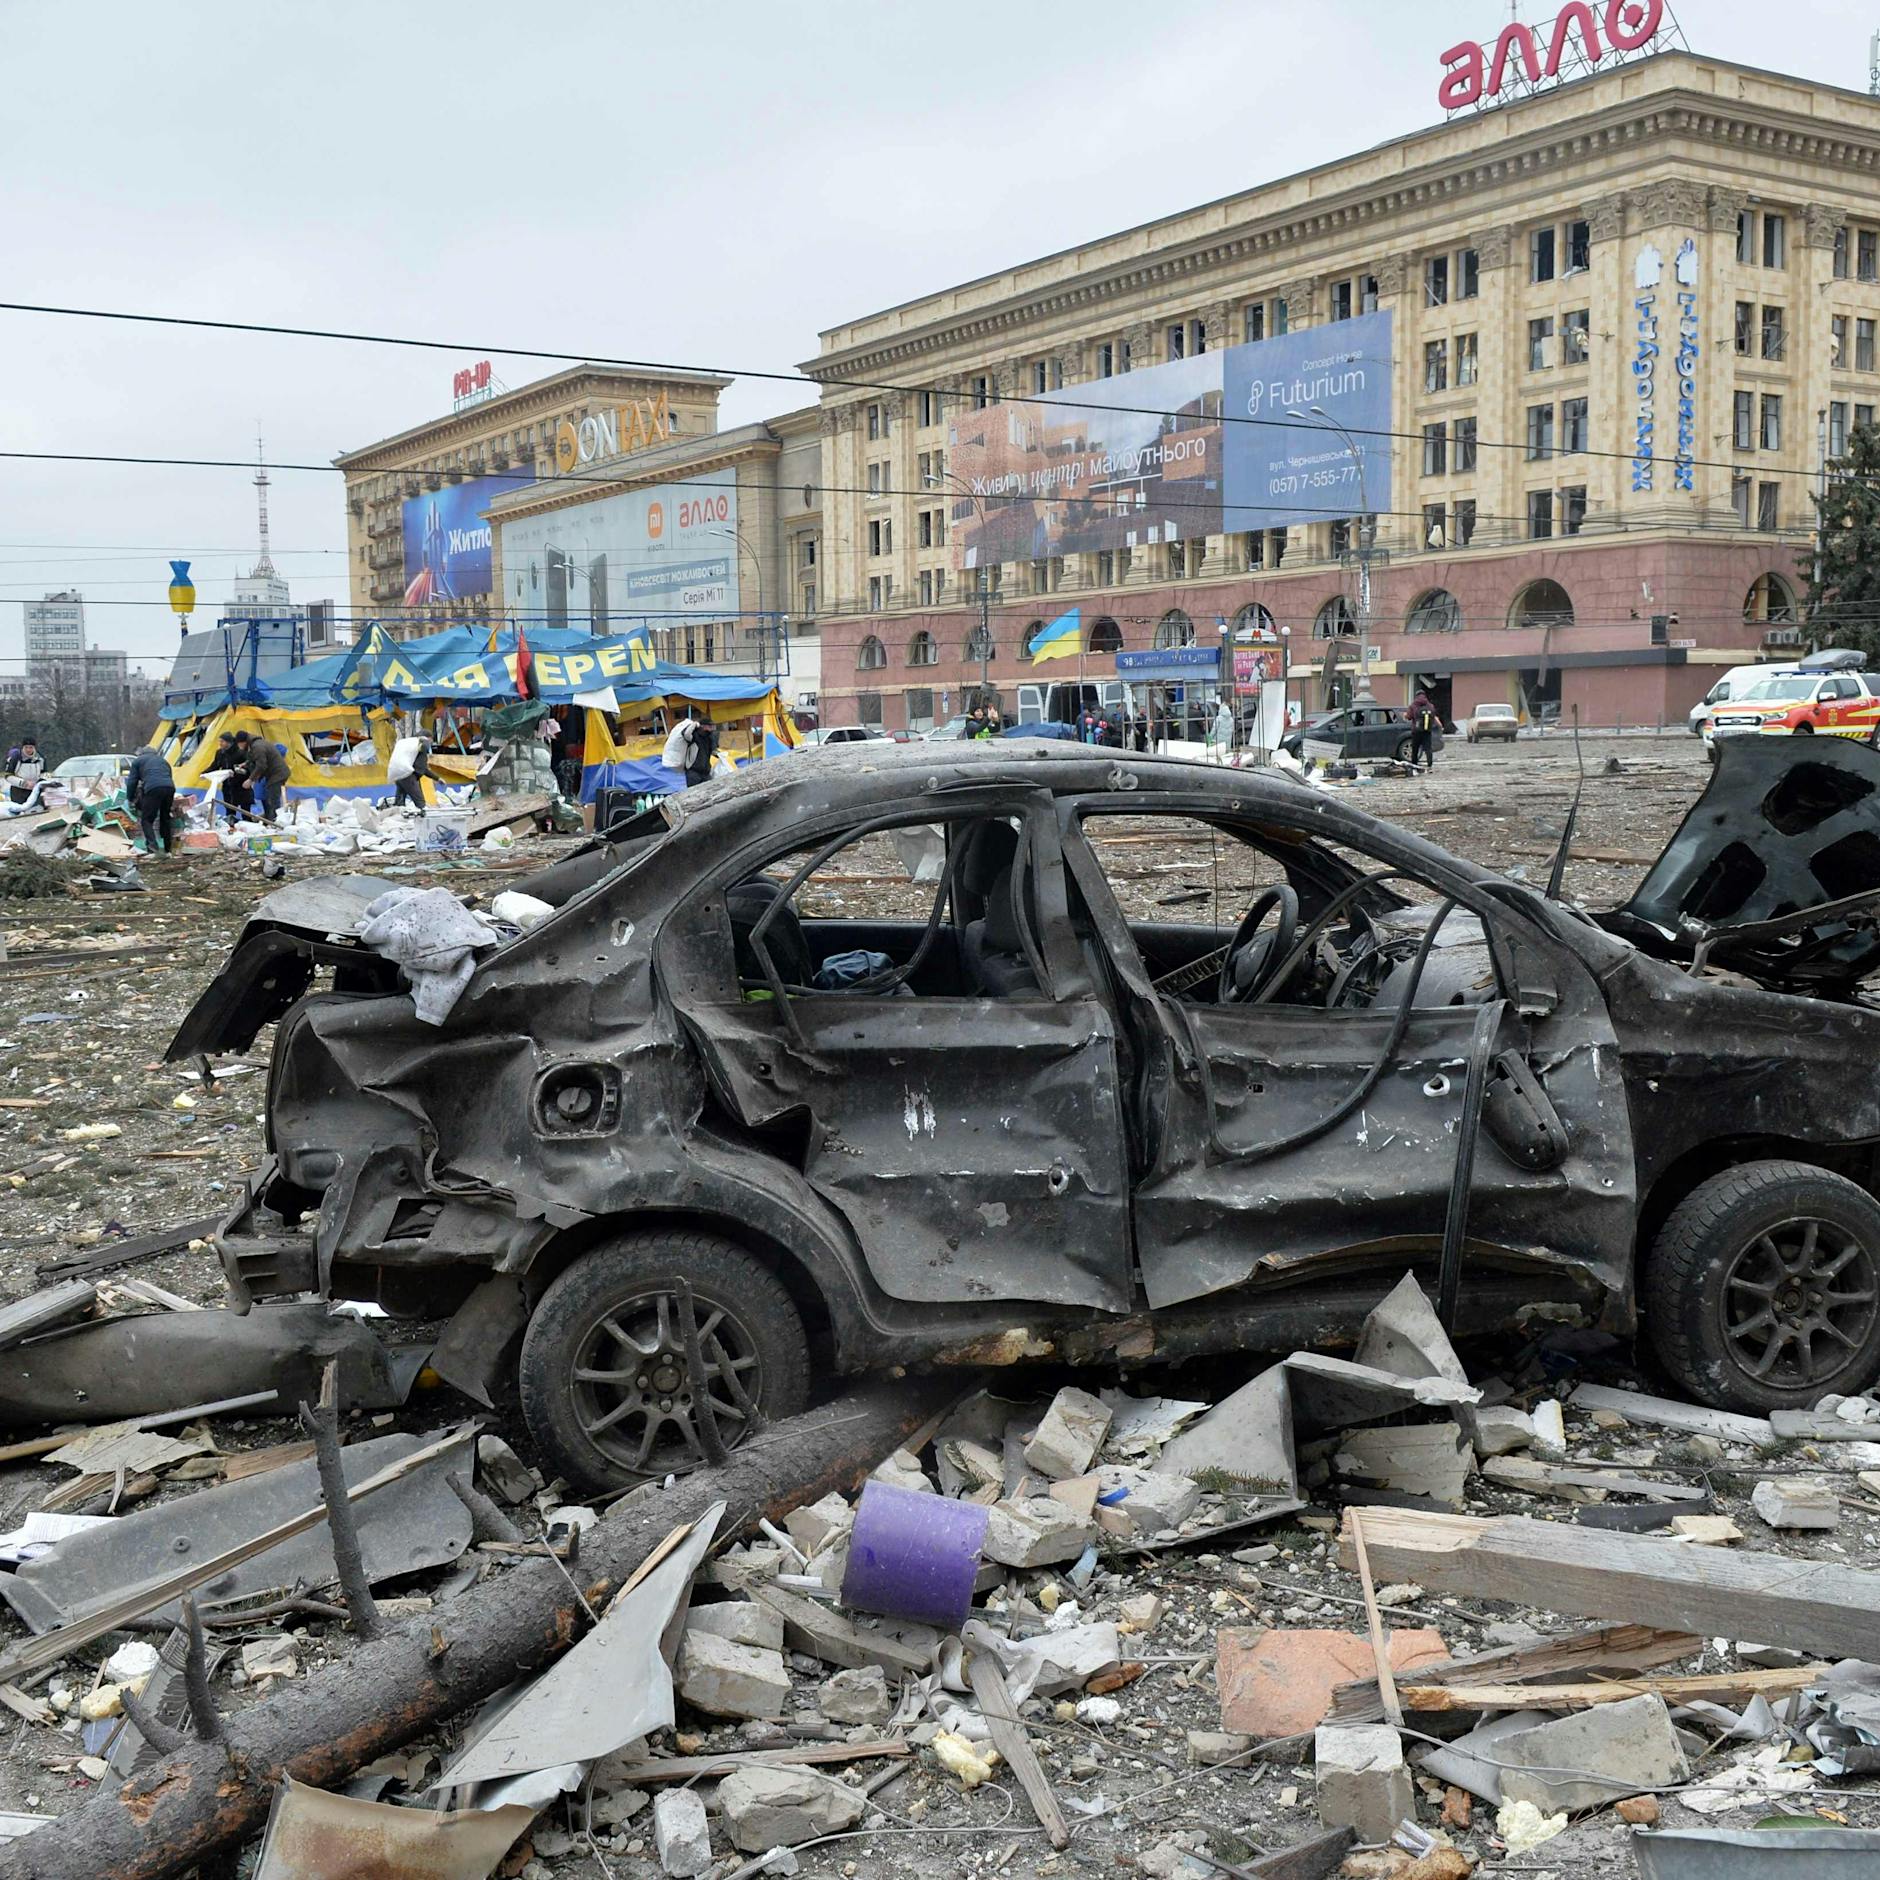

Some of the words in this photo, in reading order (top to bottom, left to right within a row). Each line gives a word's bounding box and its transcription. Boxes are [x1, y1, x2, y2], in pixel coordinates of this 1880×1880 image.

[1270, 370, 1365, 408] Futurium
[971, 475, 1010, 497] Живи
[1031, 454, 1085, 496] центрі
[1090, 437, 1206, 477] майбутнього
[1269, 476, 1298, 497] (057)
